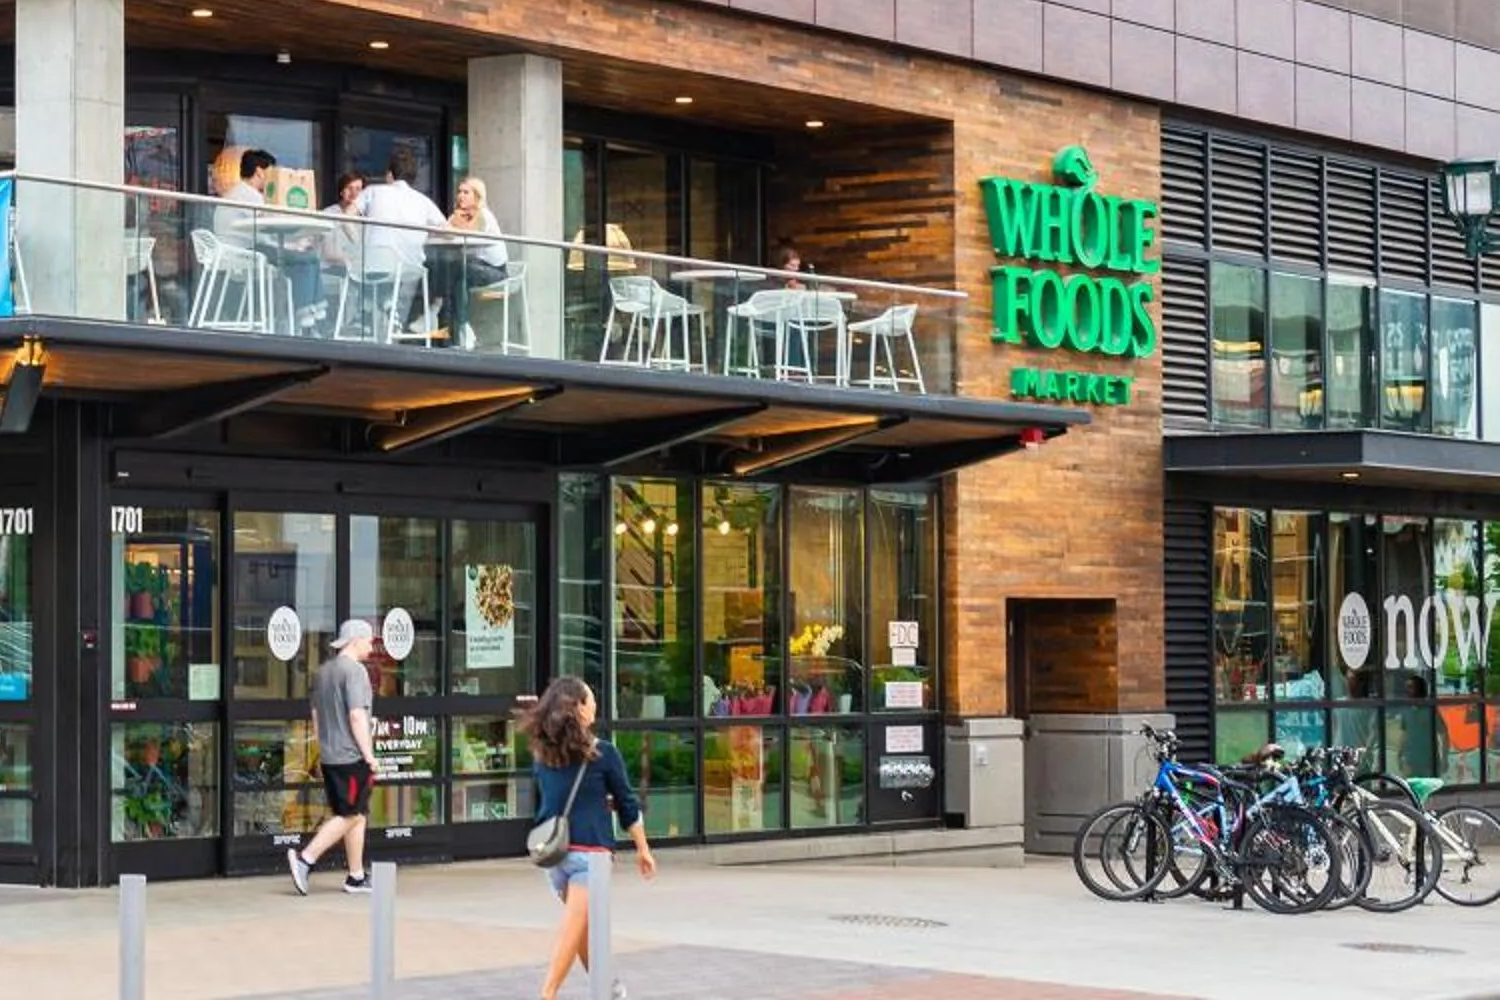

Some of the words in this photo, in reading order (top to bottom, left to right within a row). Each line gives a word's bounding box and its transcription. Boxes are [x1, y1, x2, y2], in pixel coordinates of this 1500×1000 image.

[979, 144, 1161, 275] WHOLE
[989, 265, 1157, 360] FOODS
[1010, 366, 1135, 406] MARKET
[111, 505, 143, 534] 1701
[1383, 593, 1498, 670] now
